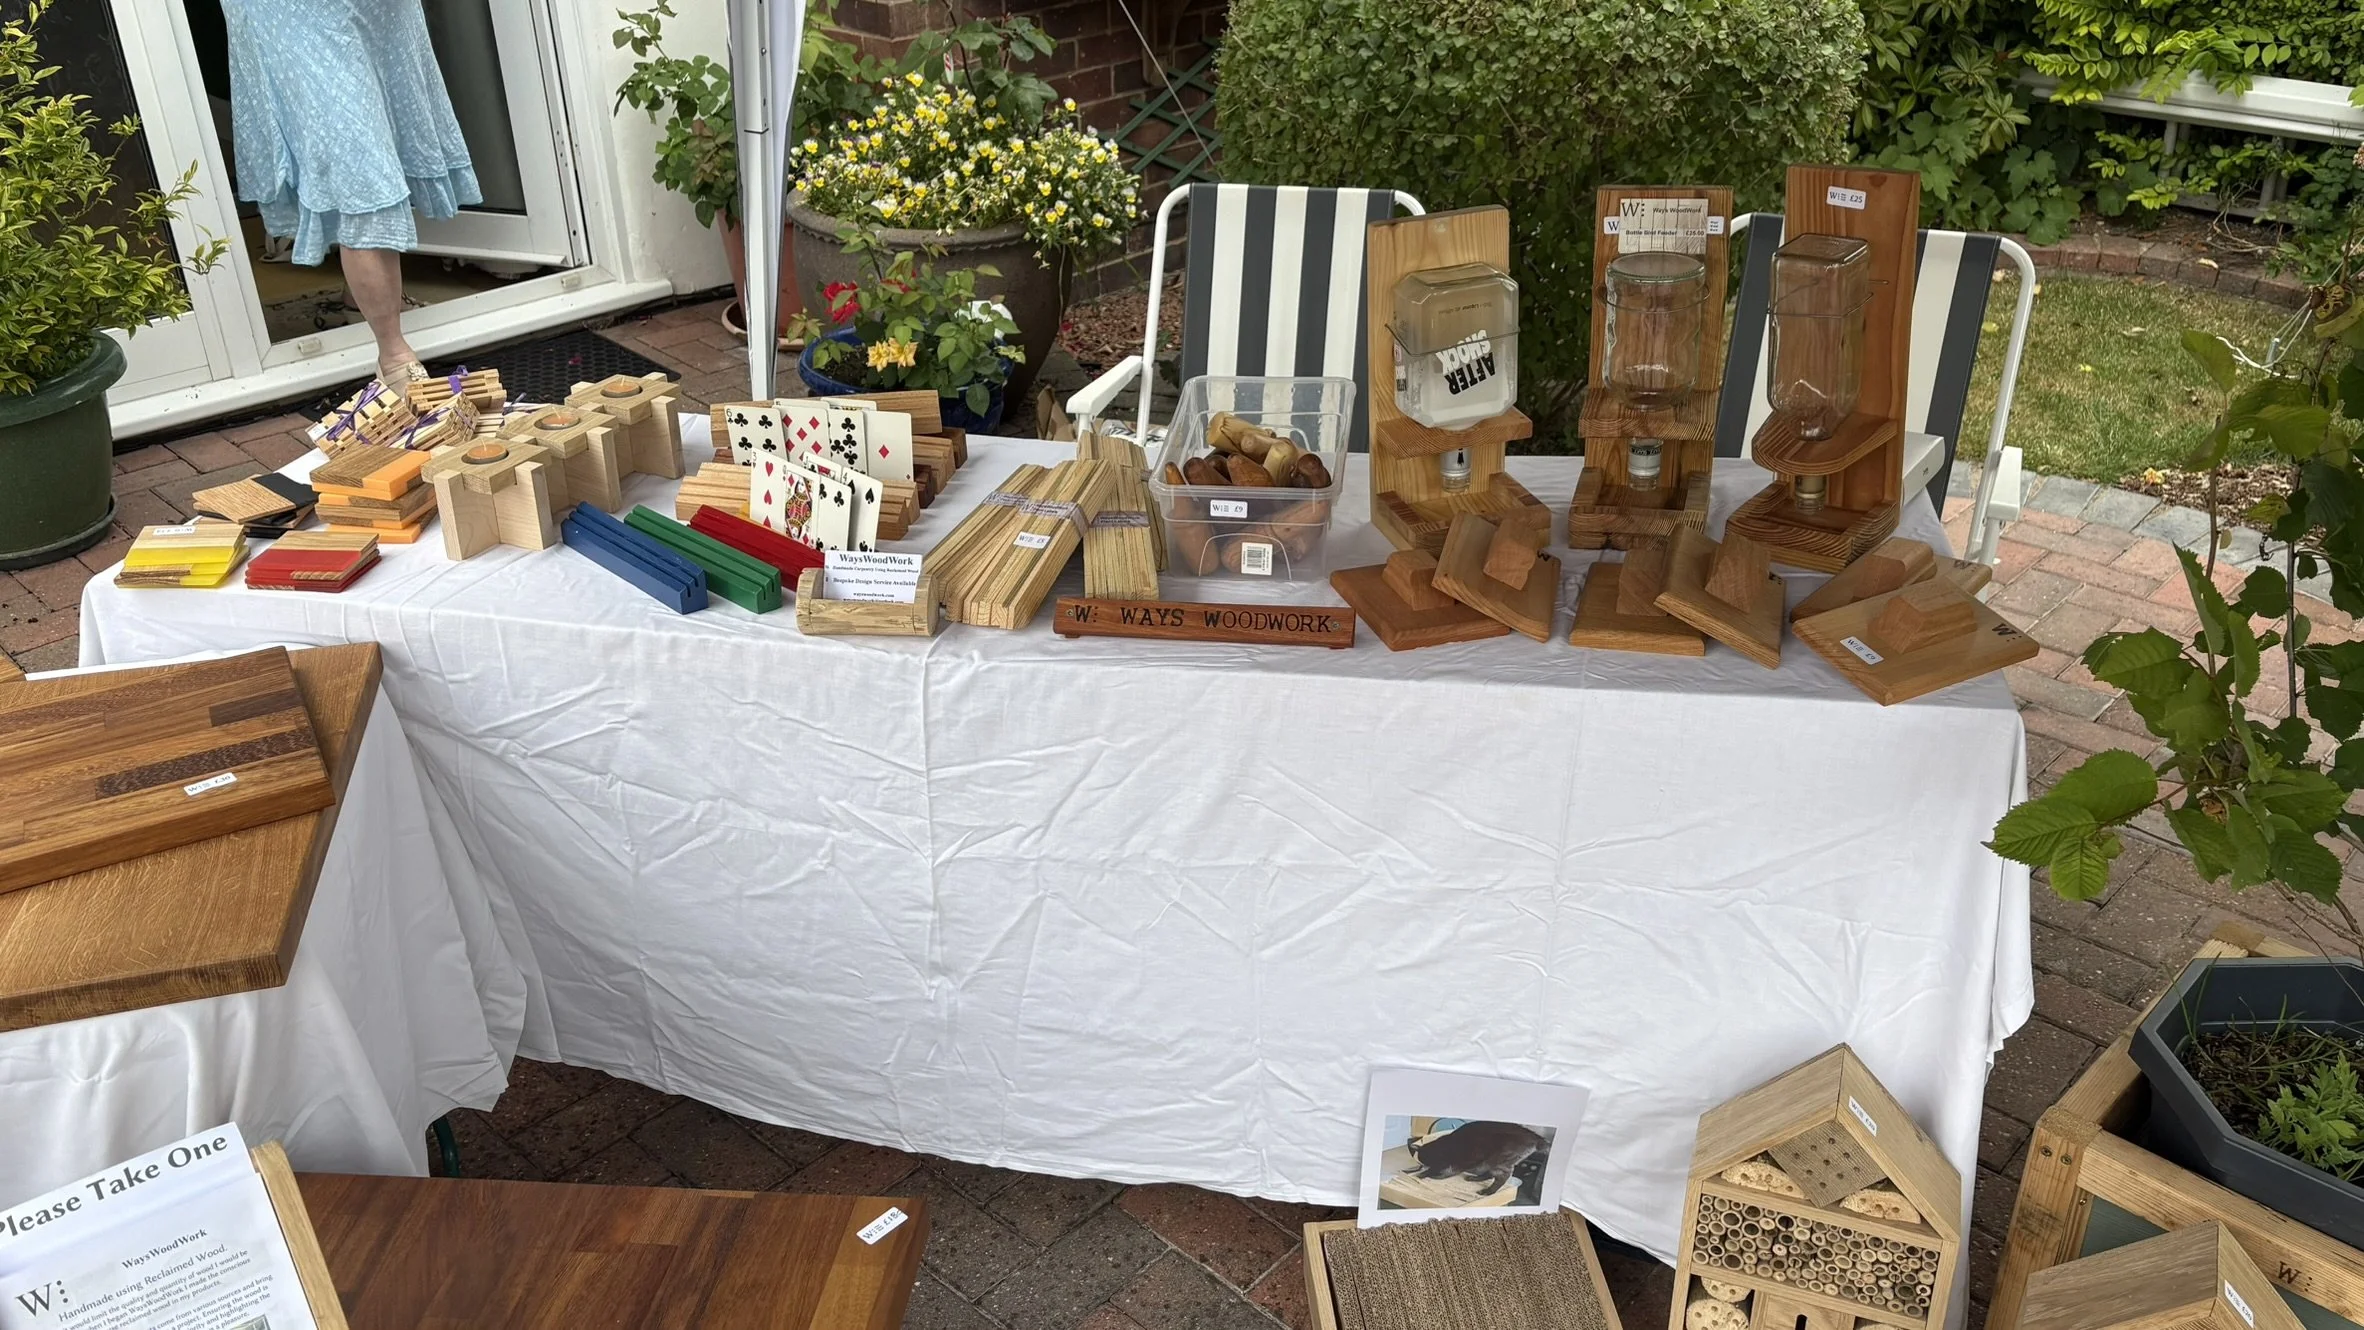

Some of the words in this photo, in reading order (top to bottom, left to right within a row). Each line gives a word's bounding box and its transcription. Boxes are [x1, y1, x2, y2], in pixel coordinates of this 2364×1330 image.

[1849, 195, 1863, 203] £25
[1436, 329, 1492, 375] SHOCK
[1444, 352, 1496, 395] AFTER
[840, 554, 914, 565] WaysWoodWork
[1120, 607, 1185, 627] WAYS
[1204, 610, 1332, 633] WOODWORK
[86, 1163, 160, 1202] Take
[167, 1137, 228, 1169] One
[122, 1228, 207, 1270] WaysWoodWork
[58, 1293, 114, 1322] Handmade
[116, 1281, 144, 1298] using
[144, 1256, 194, 1285] Reclaimed
[194, 1243, 228, 1265] Wood.
[120, 1294, 145, 1311] quality
[144, 1288, 157, 1298] and
[158, 1275, 186, 1293] quantity
[195, 1263, 214, 1276] wood
[218, 1252, 239, 1266] would
[188, 1276, 206, 1288] made
[219, 1256, 250, 1275] conscious
[241, 1281, 254, 1291] and
